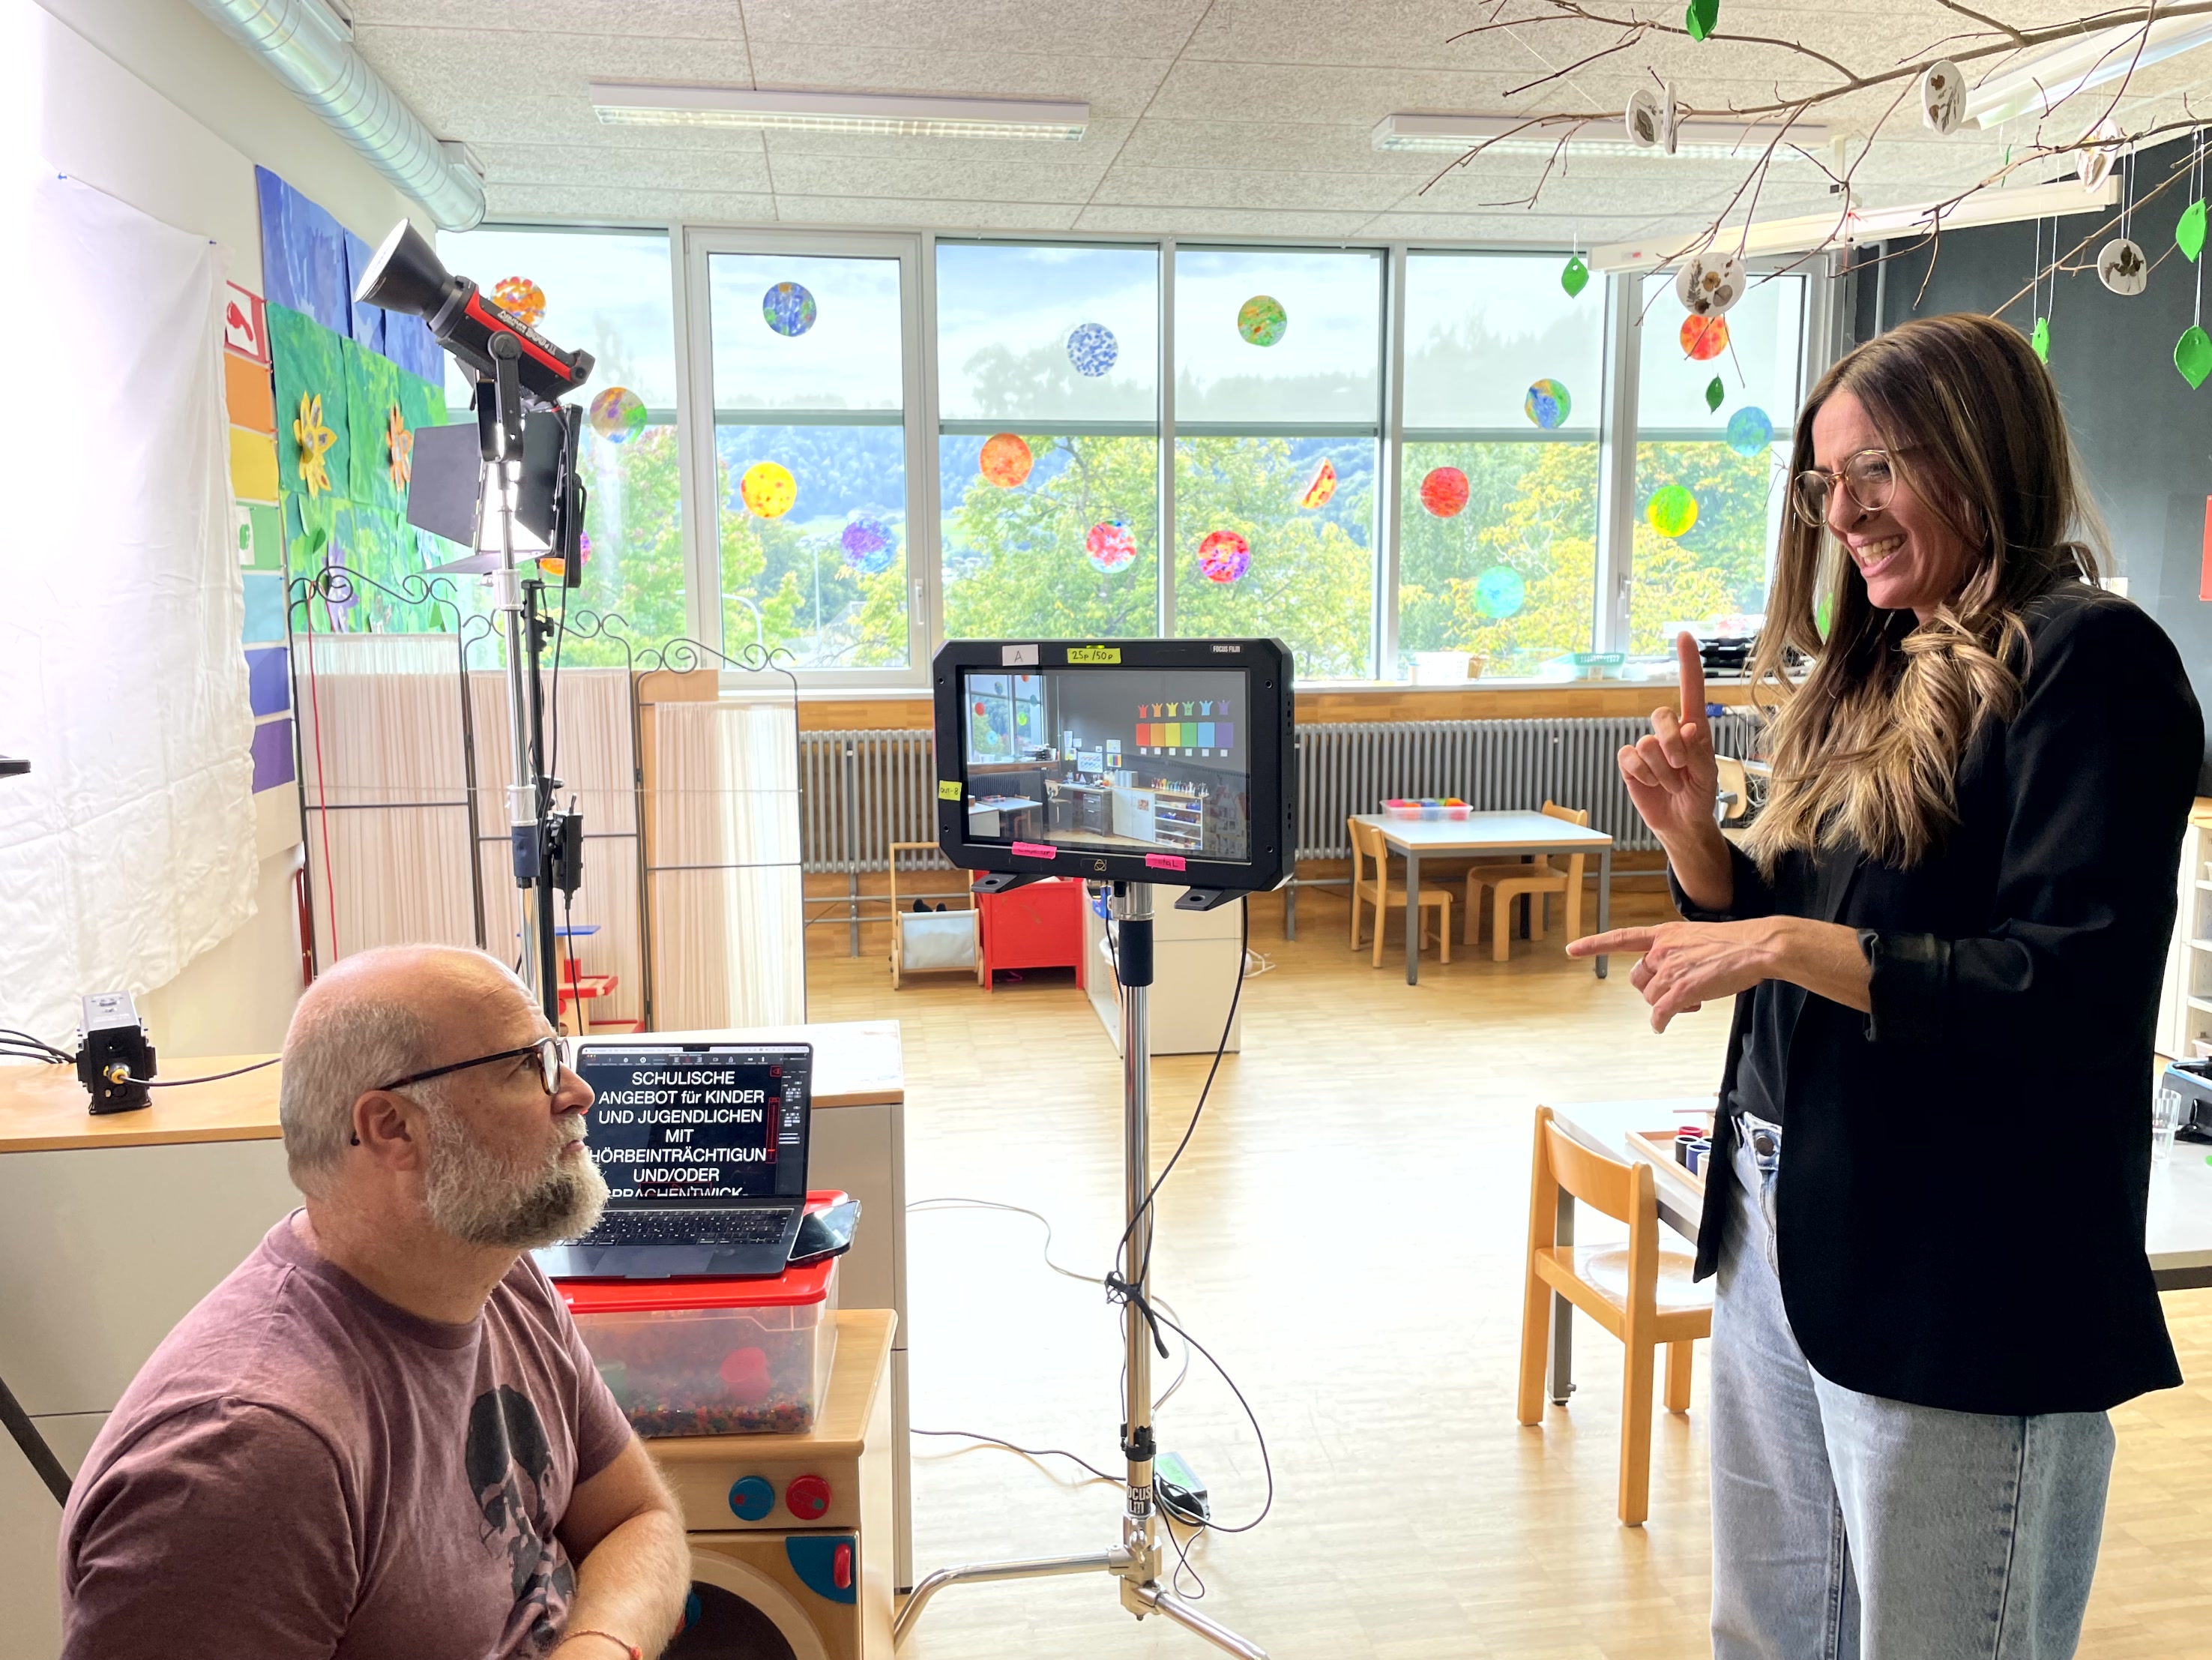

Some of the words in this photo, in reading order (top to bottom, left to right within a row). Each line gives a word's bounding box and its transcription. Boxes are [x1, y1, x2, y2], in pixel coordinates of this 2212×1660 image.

[1014, 651, 1023, 663] A
[632, 1071, 735, 1085] SCHULISCHE
[598, 1090, 678, 1104] ANGEBOT
[681, 1089, 702, 1104] für
[705, 1089, 765, 1104] KINDER
[599, 1110, 634, 1124] UND
[637, 1109, 762, 1124] JUGENDLICHEN
[666, 1128, 695, 1143] MIT
[589, 1146, 766, 1163] HÖRBEINTRÄCHTIGUN
[633, 1167, 720, 1182] UND/ODER
[1127, 1485, 1151, 1500] OCUS
